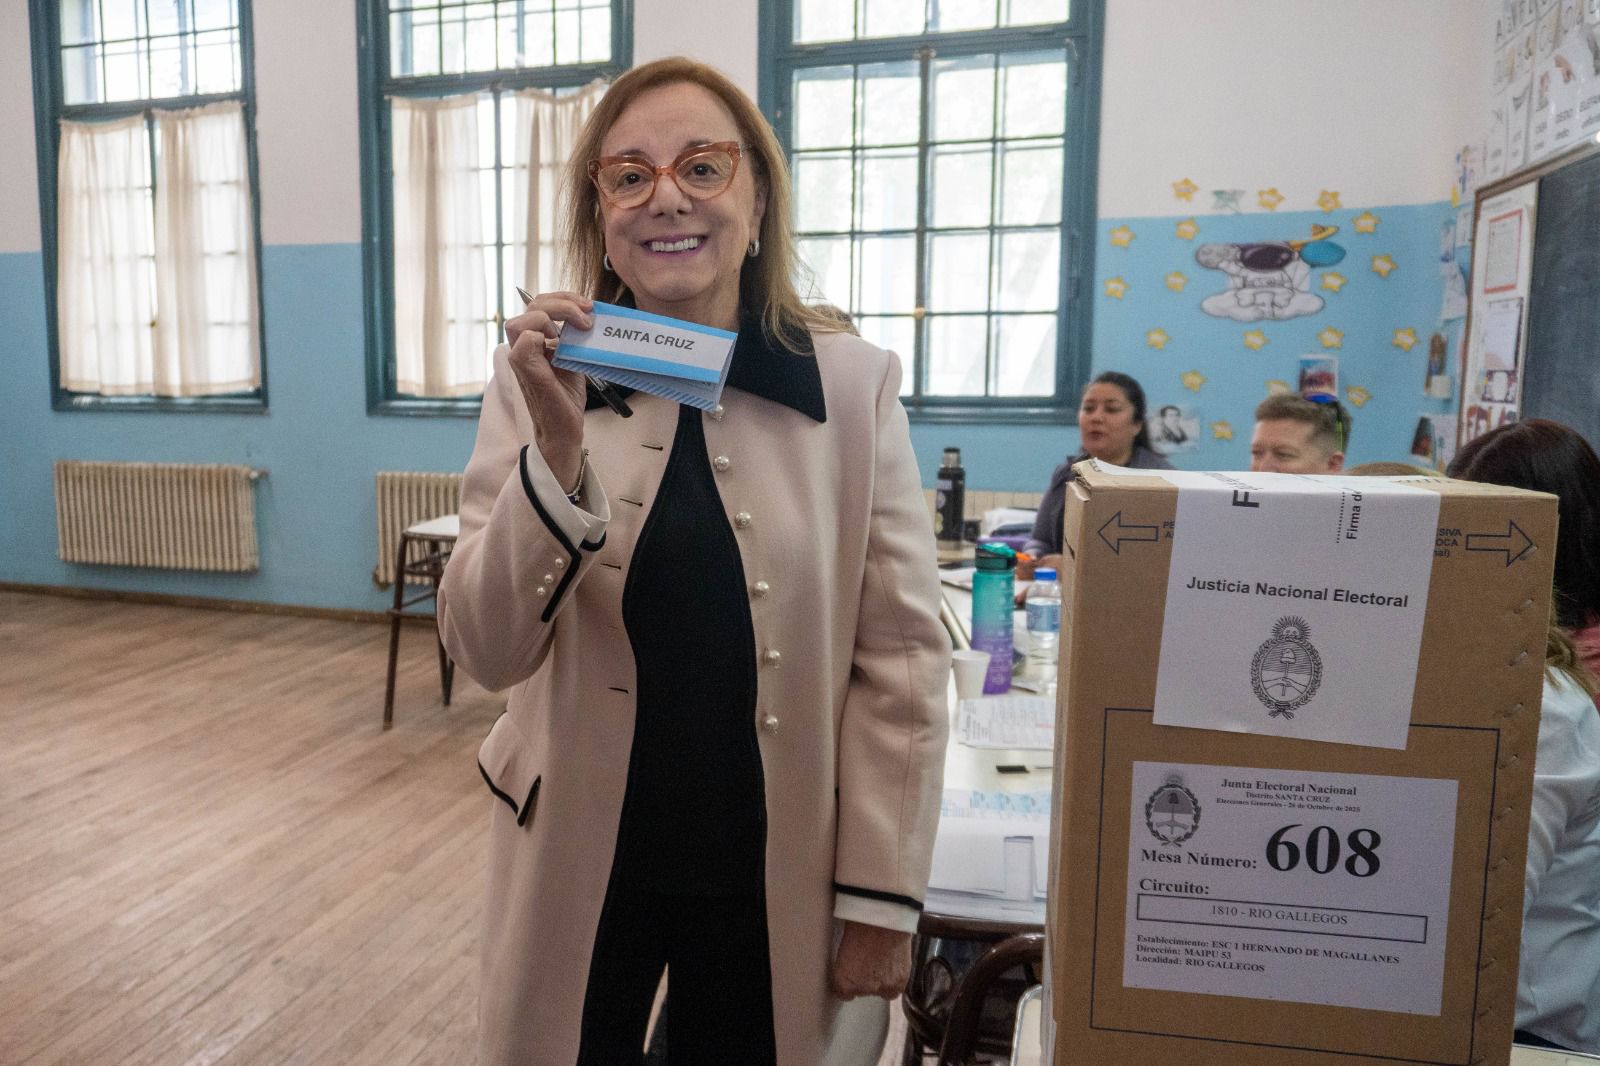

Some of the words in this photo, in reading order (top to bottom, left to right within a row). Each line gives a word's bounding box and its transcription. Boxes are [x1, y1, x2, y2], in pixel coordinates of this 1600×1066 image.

[602, 326, 650, 343] SANTA
[654, 334, 696, 350] CRUZ
[1346, 505, 1361, 540] Firma
[1439, 528, 1462, 536] SIVA
[1186, 576, 1250, 594] Justicia
[1255, 582, 1328, 600] Nacional
[1333, 589, 1408, 608] Electoral
[1221, 779, 1252, 790] Junta
[1256, 780, 1305, 792] Electoral
[1308, 784, 1357, 796] Nacional
[1141, 849, 1182, 864] Mesa
[1187, 852, 1258, 869] Número:
[1265, 824, 1382, 878] 608
[1139, 878, 1210, 895] Circuito:
[1212, 905, 1238, 918] 1810
[1249, 908, 1272, 920] RIO
[1275, 910, 1348, 926] GALLEGOS
[1136, 934, 1209, 948] Establecimiento:
[1212, 940, 1232, 949] ESC
[1242, 942, 1302, 956] HERNANDO
[1306, 948, 1319, 956] DE
[1322, 949, 1400, 964] MAGALLANES
[1184, 948, 1218, 958] MAIPU
[1222, 952, 1232, 960] 53
[1136, 954, 1182, 965] Localidad:
[1186, 958, 1205, 967] RIO
[1208, 960, 1265, 972] GALLEGOS
